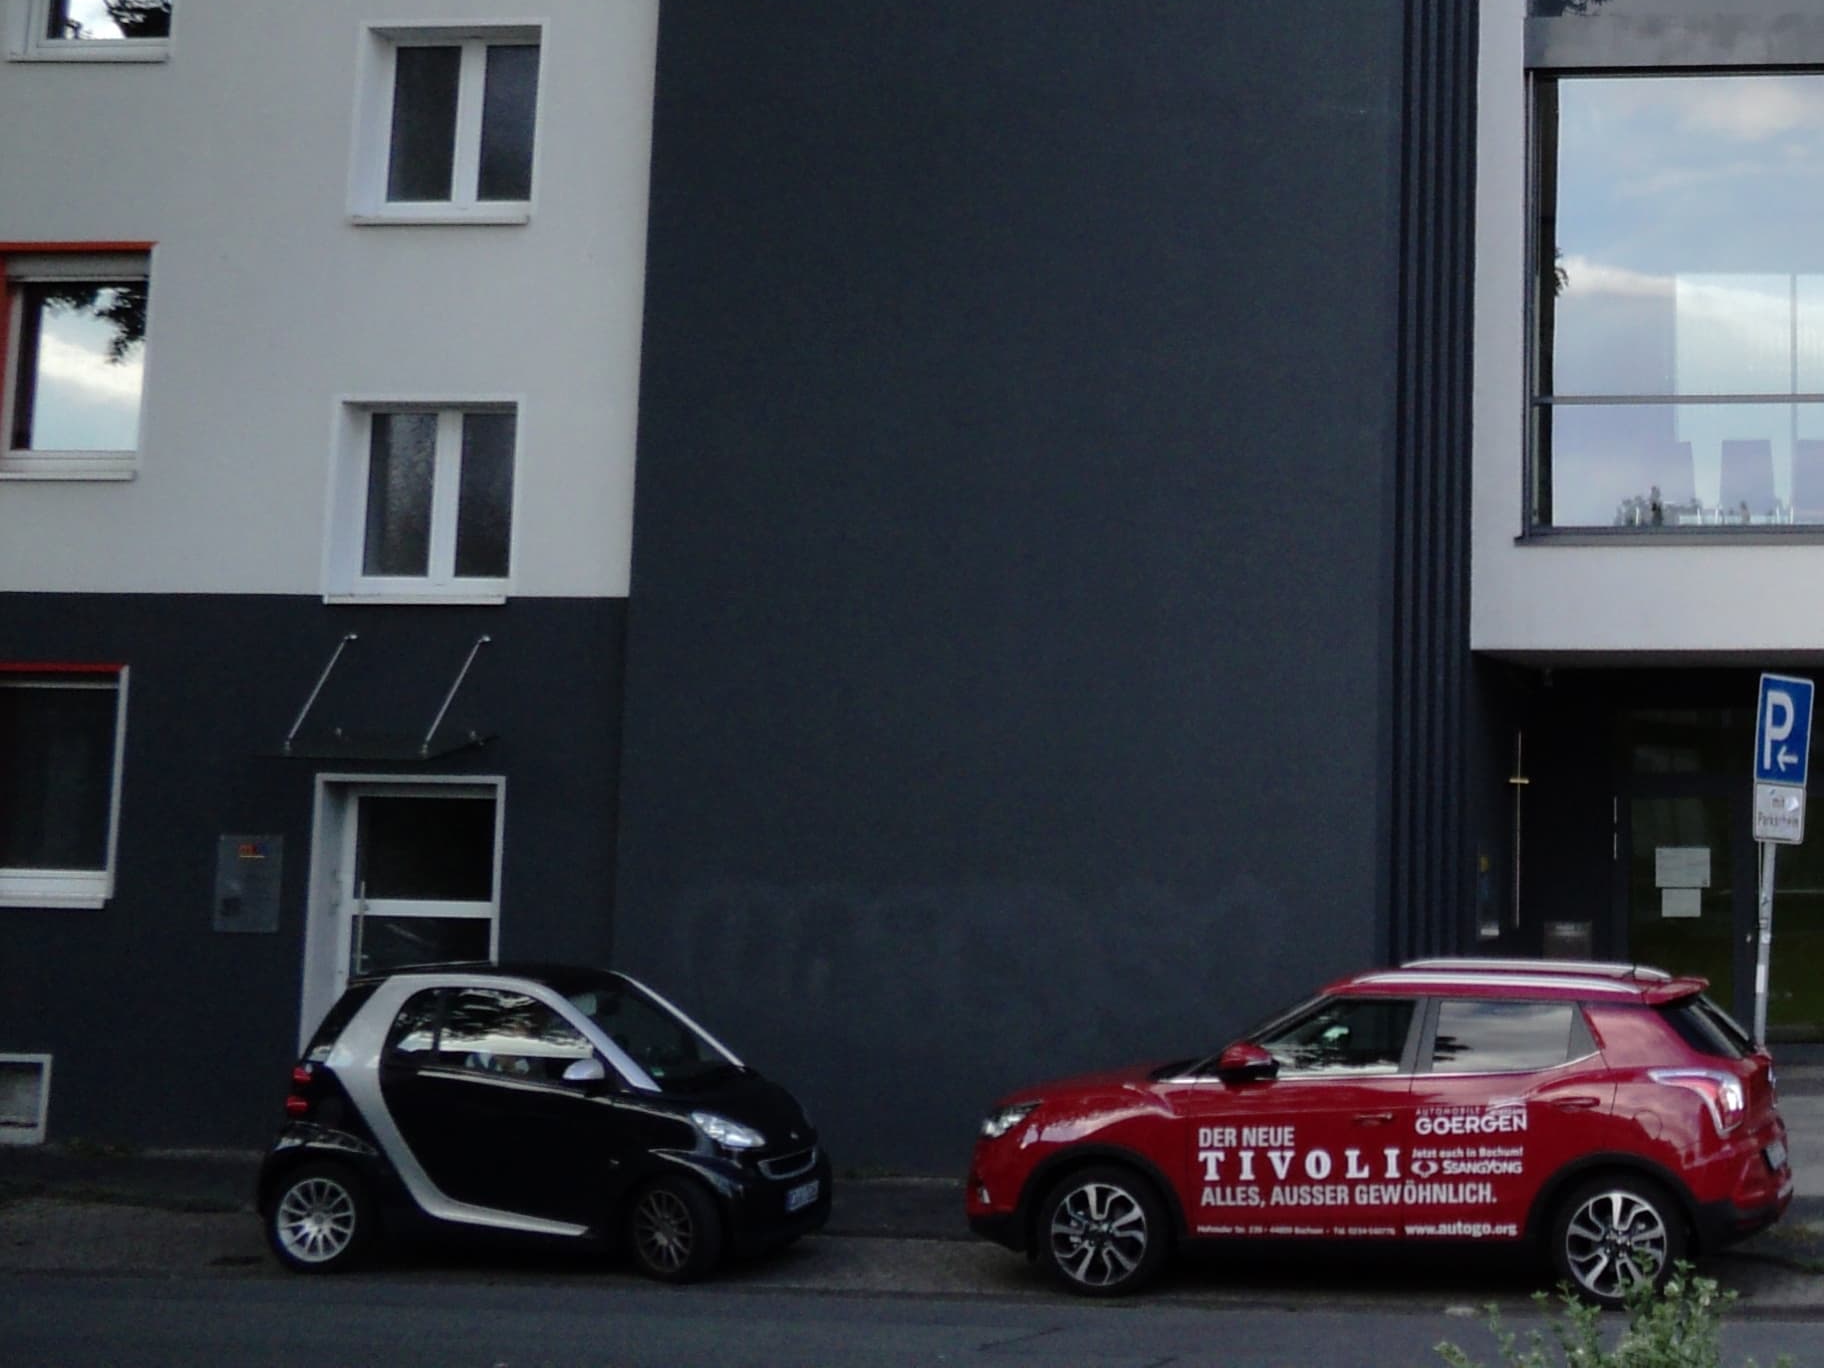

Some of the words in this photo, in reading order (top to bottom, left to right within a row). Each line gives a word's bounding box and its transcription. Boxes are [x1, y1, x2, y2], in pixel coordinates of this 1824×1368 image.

[1763, 690, 1795, 770] P
[1415, 1114, 1528, 1135] GOERGEN
[1199, 1127, 1237, 1148] DER
[1242, 1126, 1295, 1147] NEUE
[1466, 1147, 1477, 1157] in
[1198, 1148, 1401, 1181] TIVOLI
[1200, 1186, 1265, 1208] ALLES,
[1270, 1185, 1349, 1206] AUSSER
[1355, 1179, 1498, 1206] GEWÖHNLICH.
[1404, 1221, 1518, 1237] www.autogo.org
